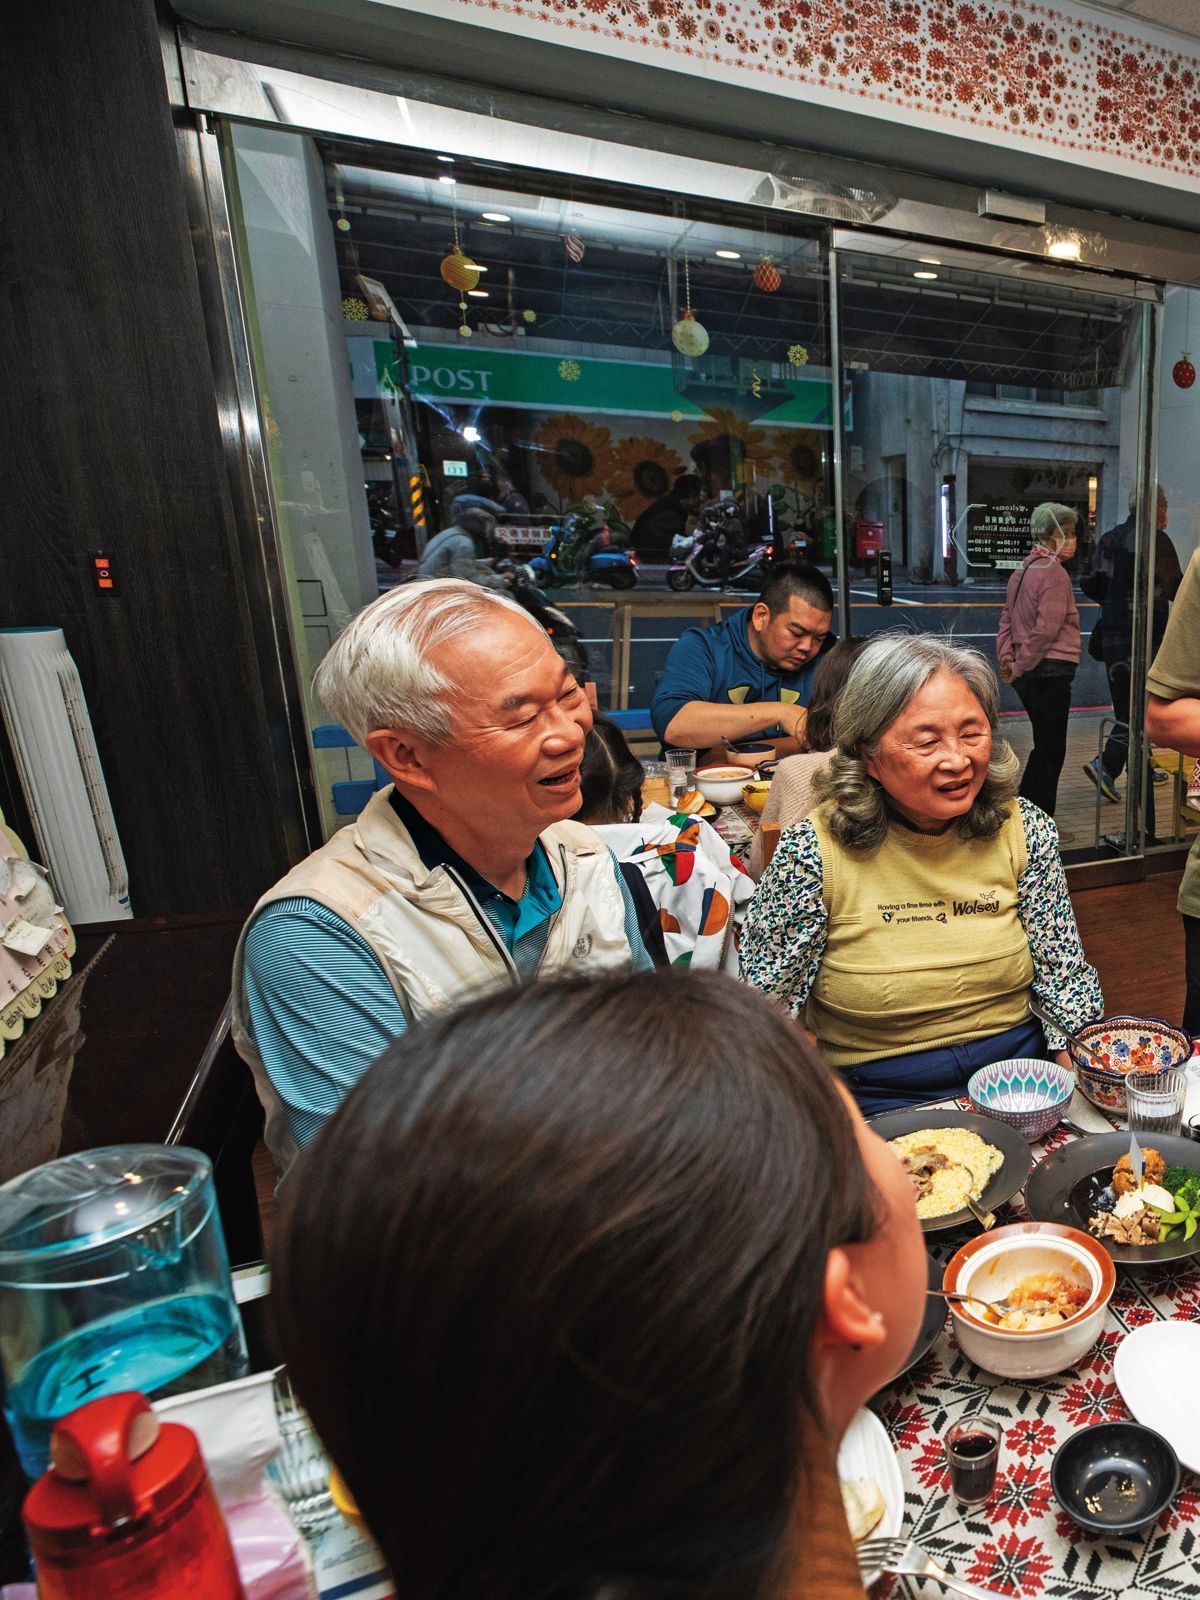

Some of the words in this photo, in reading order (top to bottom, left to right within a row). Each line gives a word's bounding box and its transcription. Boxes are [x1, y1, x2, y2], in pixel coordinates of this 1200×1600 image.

[410, 365, 492, 391] POST
[877, 903, 900, 912] Having
[918, 901, 932, 909] time
[933, 900, 946, 908] with
[952, 899, 1000, 917] Wolsey
[896, 917, 911, 925] your
